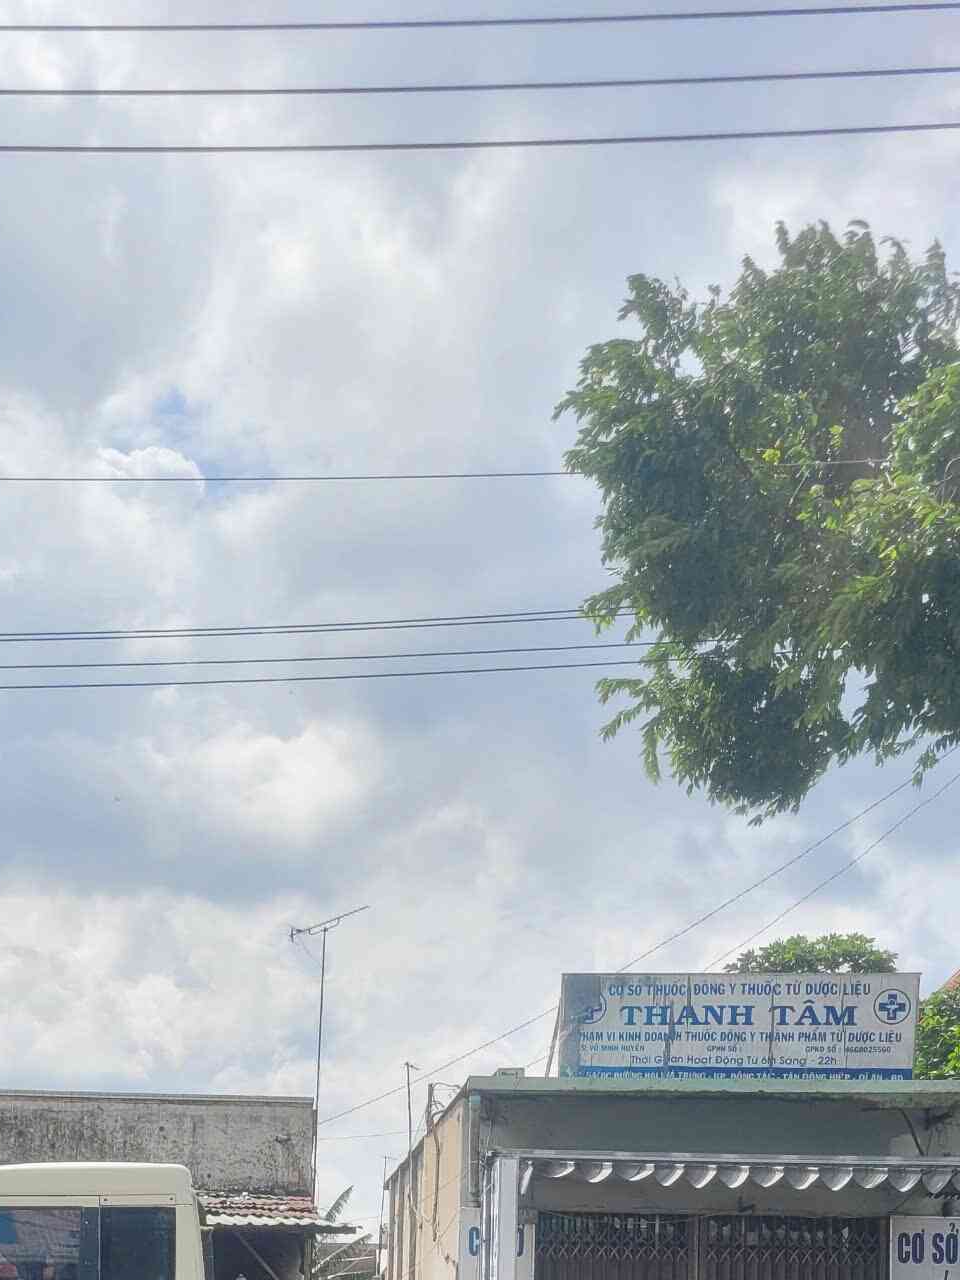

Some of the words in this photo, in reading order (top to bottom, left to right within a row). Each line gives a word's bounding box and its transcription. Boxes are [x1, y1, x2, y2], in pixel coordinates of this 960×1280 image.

[729, 983, 737, 995] Y
[620, 1004, 756, 1026] THANH
[768, 999, 858, 1026] TÂM
[619, 1031, 641, 1042] KINH
[749, 1031, 756, 1043] Y
[896, 1228, 925, 1264] CƠ
[931, 1222, 960, 1265] SỞ
